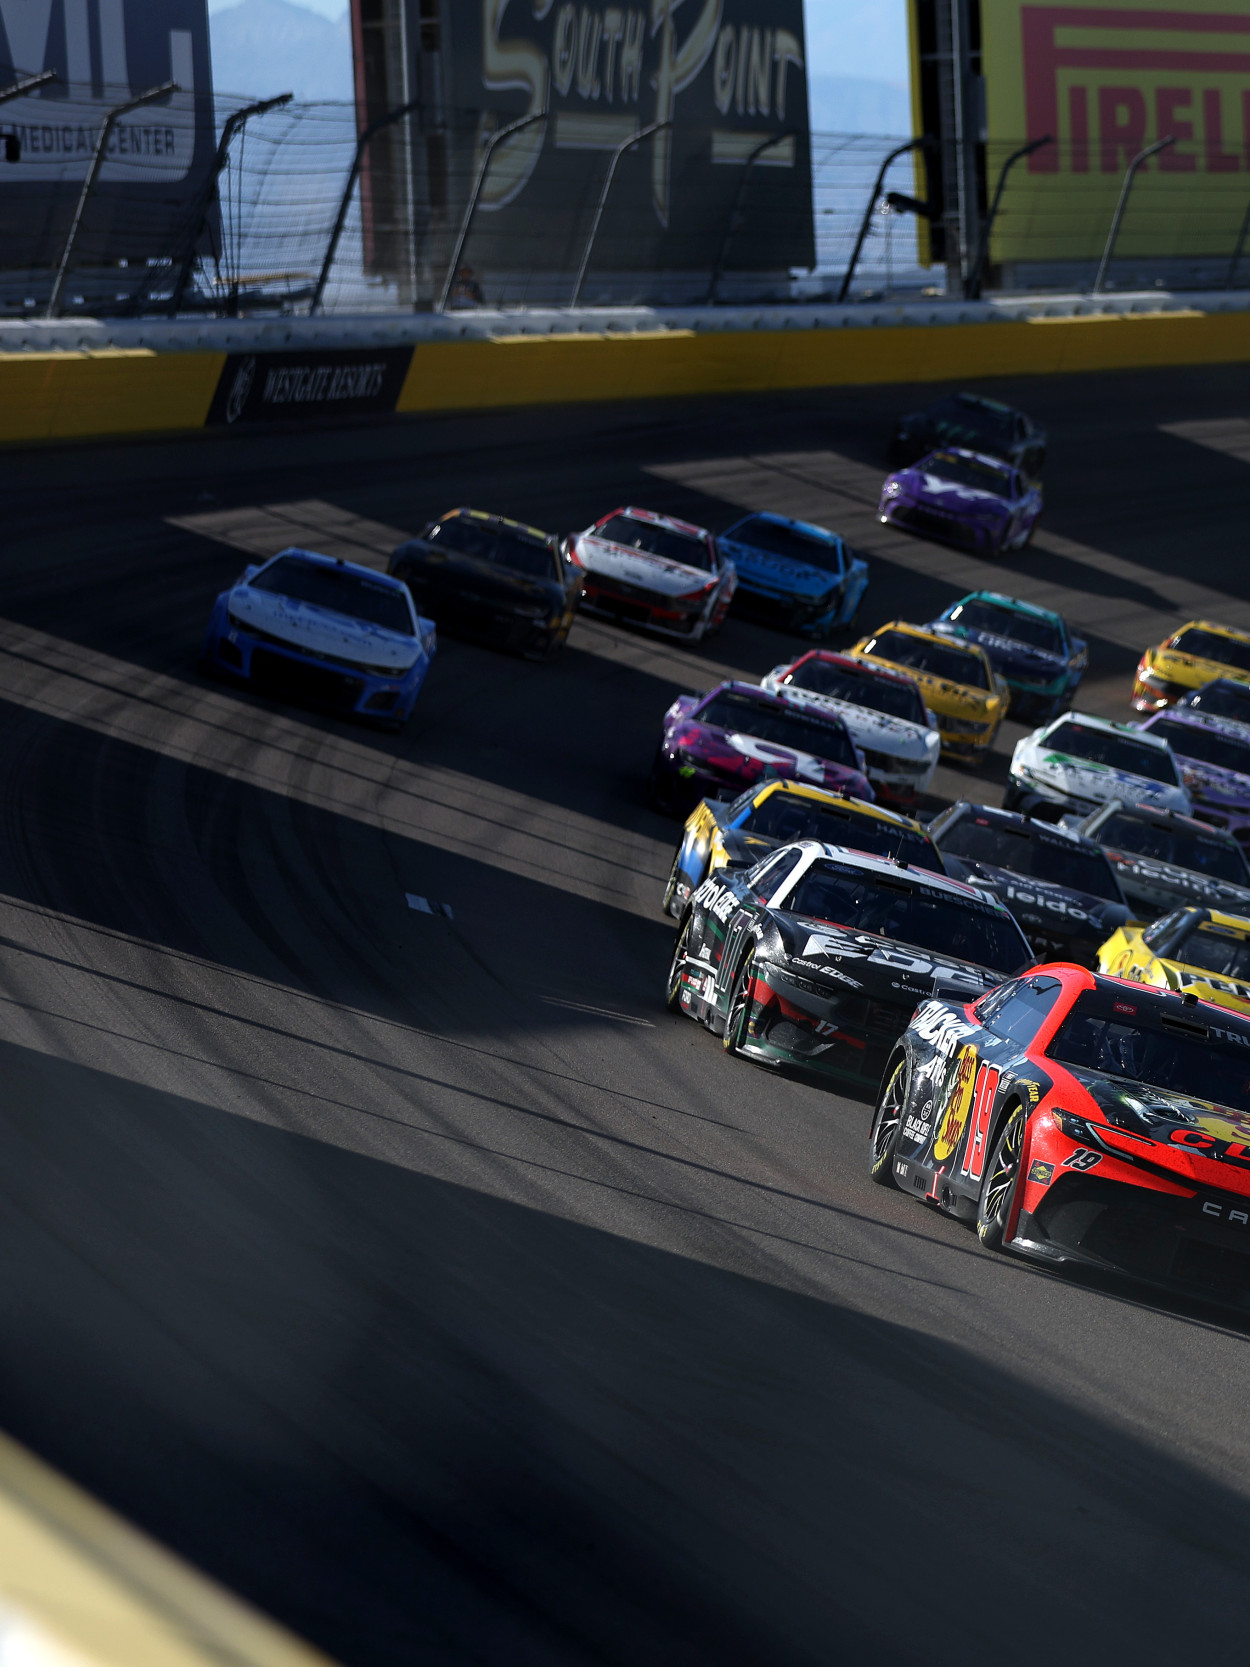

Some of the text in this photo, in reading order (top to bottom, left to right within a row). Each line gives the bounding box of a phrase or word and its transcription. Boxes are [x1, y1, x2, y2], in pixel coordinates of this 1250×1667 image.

[475, 0, 803, 231] SOUTH POINT
[106, 128, 175, 155] CENTER
[1006, 885, 1104, 930] leidos
[792, 956, 865, 990] Castrol EDGE
[901, 984, 932, 997] Castro
[815, 1019, 839, 1037] 17
[960, 1059, 1002, 1181] 19
[1060, 1147, 1103, 1172] 19
